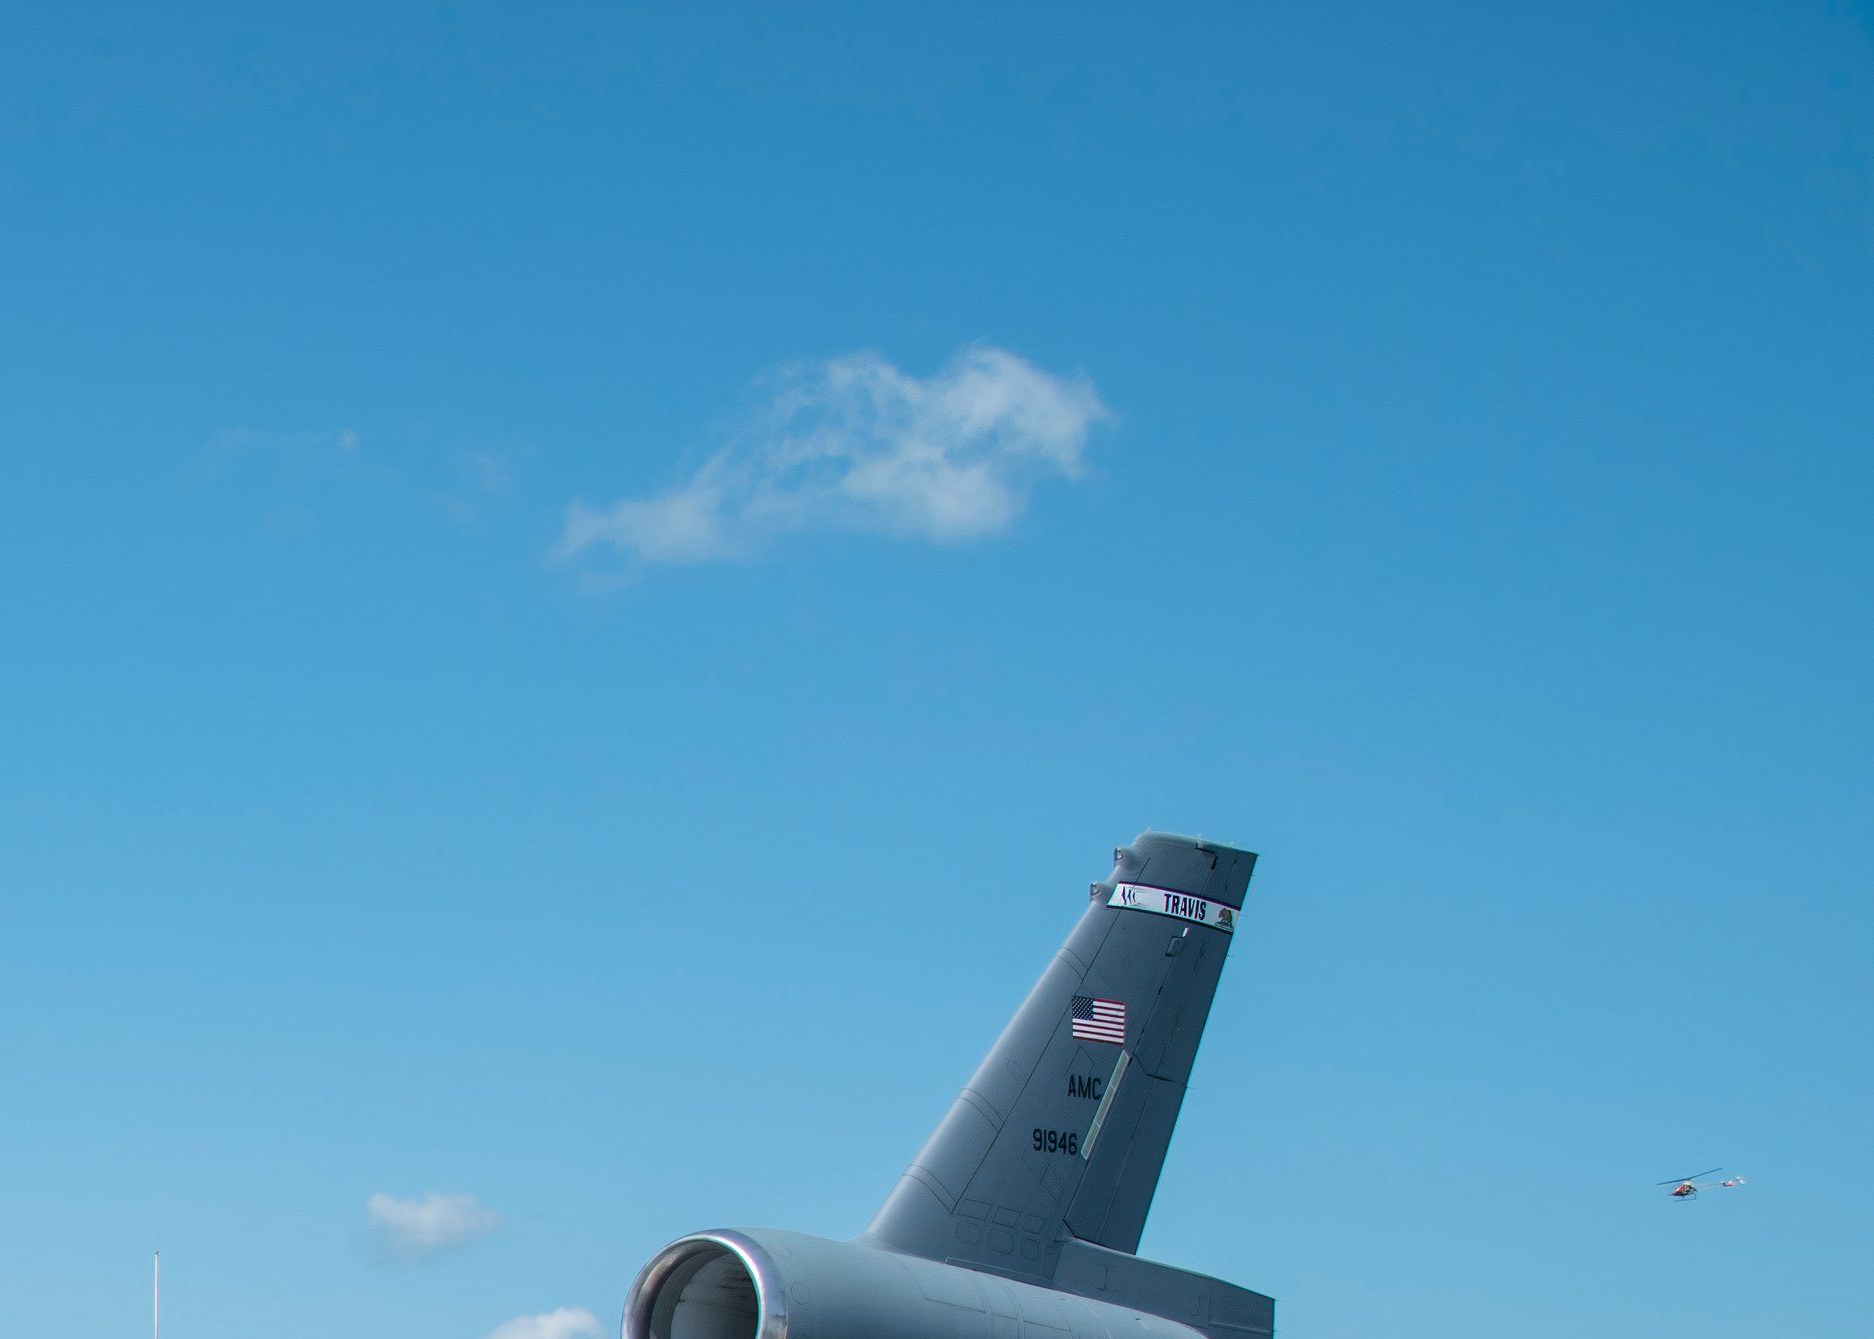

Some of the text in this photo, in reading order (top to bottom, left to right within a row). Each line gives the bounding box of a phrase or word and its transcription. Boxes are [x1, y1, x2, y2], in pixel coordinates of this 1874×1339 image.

[1162, 892, 1207, 921] TRAVIS
[1067, 1074, 1101, 1100] AMC
[1032, 1128, 1078, 1156] 91946
